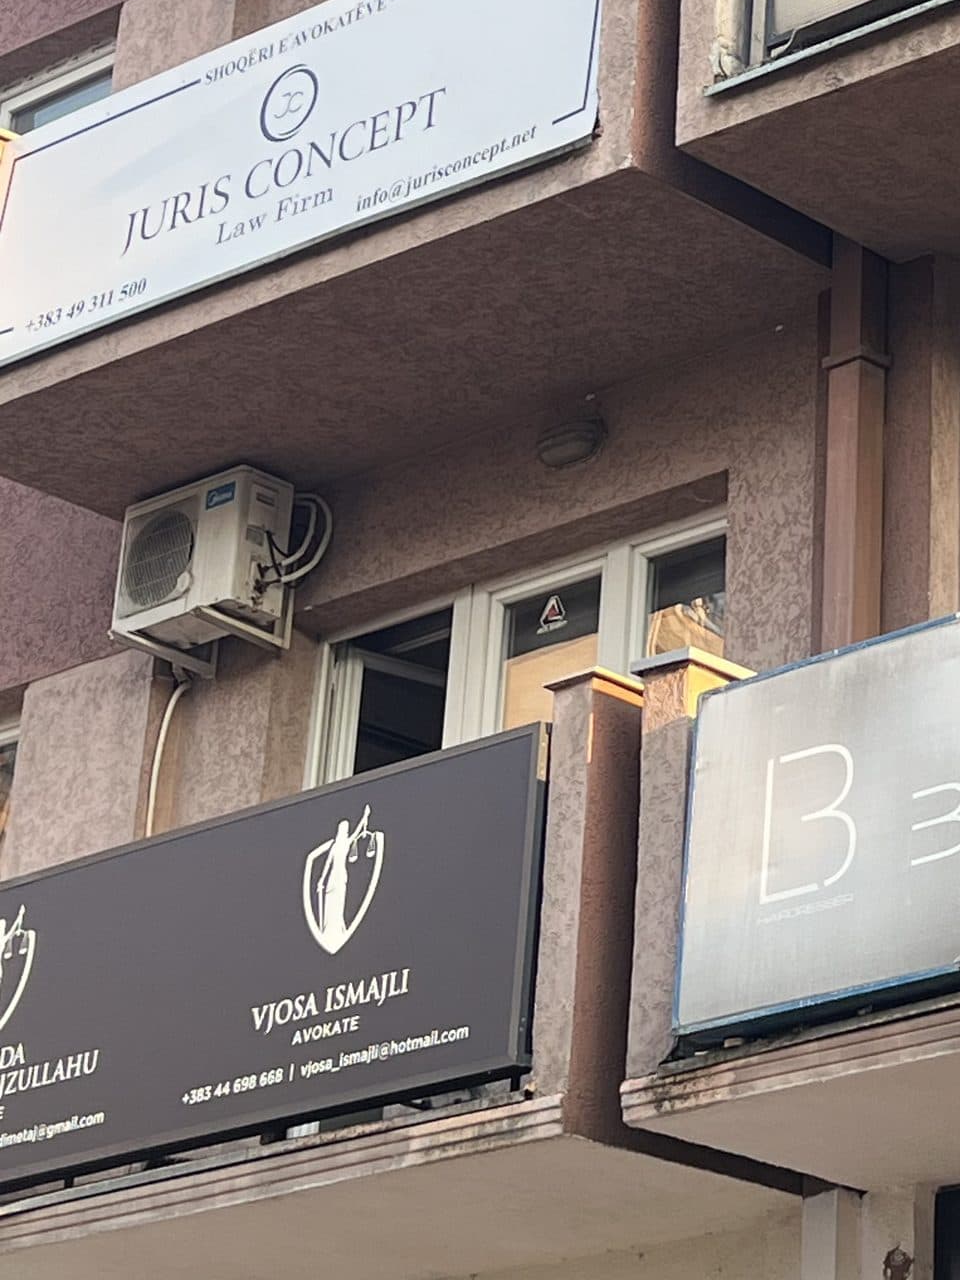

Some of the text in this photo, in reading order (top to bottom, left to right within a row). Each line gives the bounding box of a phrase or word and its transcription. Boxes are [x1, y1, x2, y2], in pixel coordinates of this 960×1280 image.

[204, 43, 274, 86] SHOQËRI
[121, 87, 447, 257] JURIS CONCEPT
[356, 125, 537, 212] info@jurisconcept.net
[214, 186, 334, 245] Law Firm
[25, 277, 148, 333] +383 49 311 500
[758, 743, 857, 905] B
[251, 968, 411, 1035] VJOSA ISMAJLI
[291, 1015, 361, 1046] AVOKATE
[181, 1083, 212, 1106] +383
[213, 1080, 231, 1098] 44
[232, 1074, 258, 1093] 698
[259, 1067, 284, 1088] 668
[300, 1024, 470, 1079] vjosa_ismajli@hotmail.com
